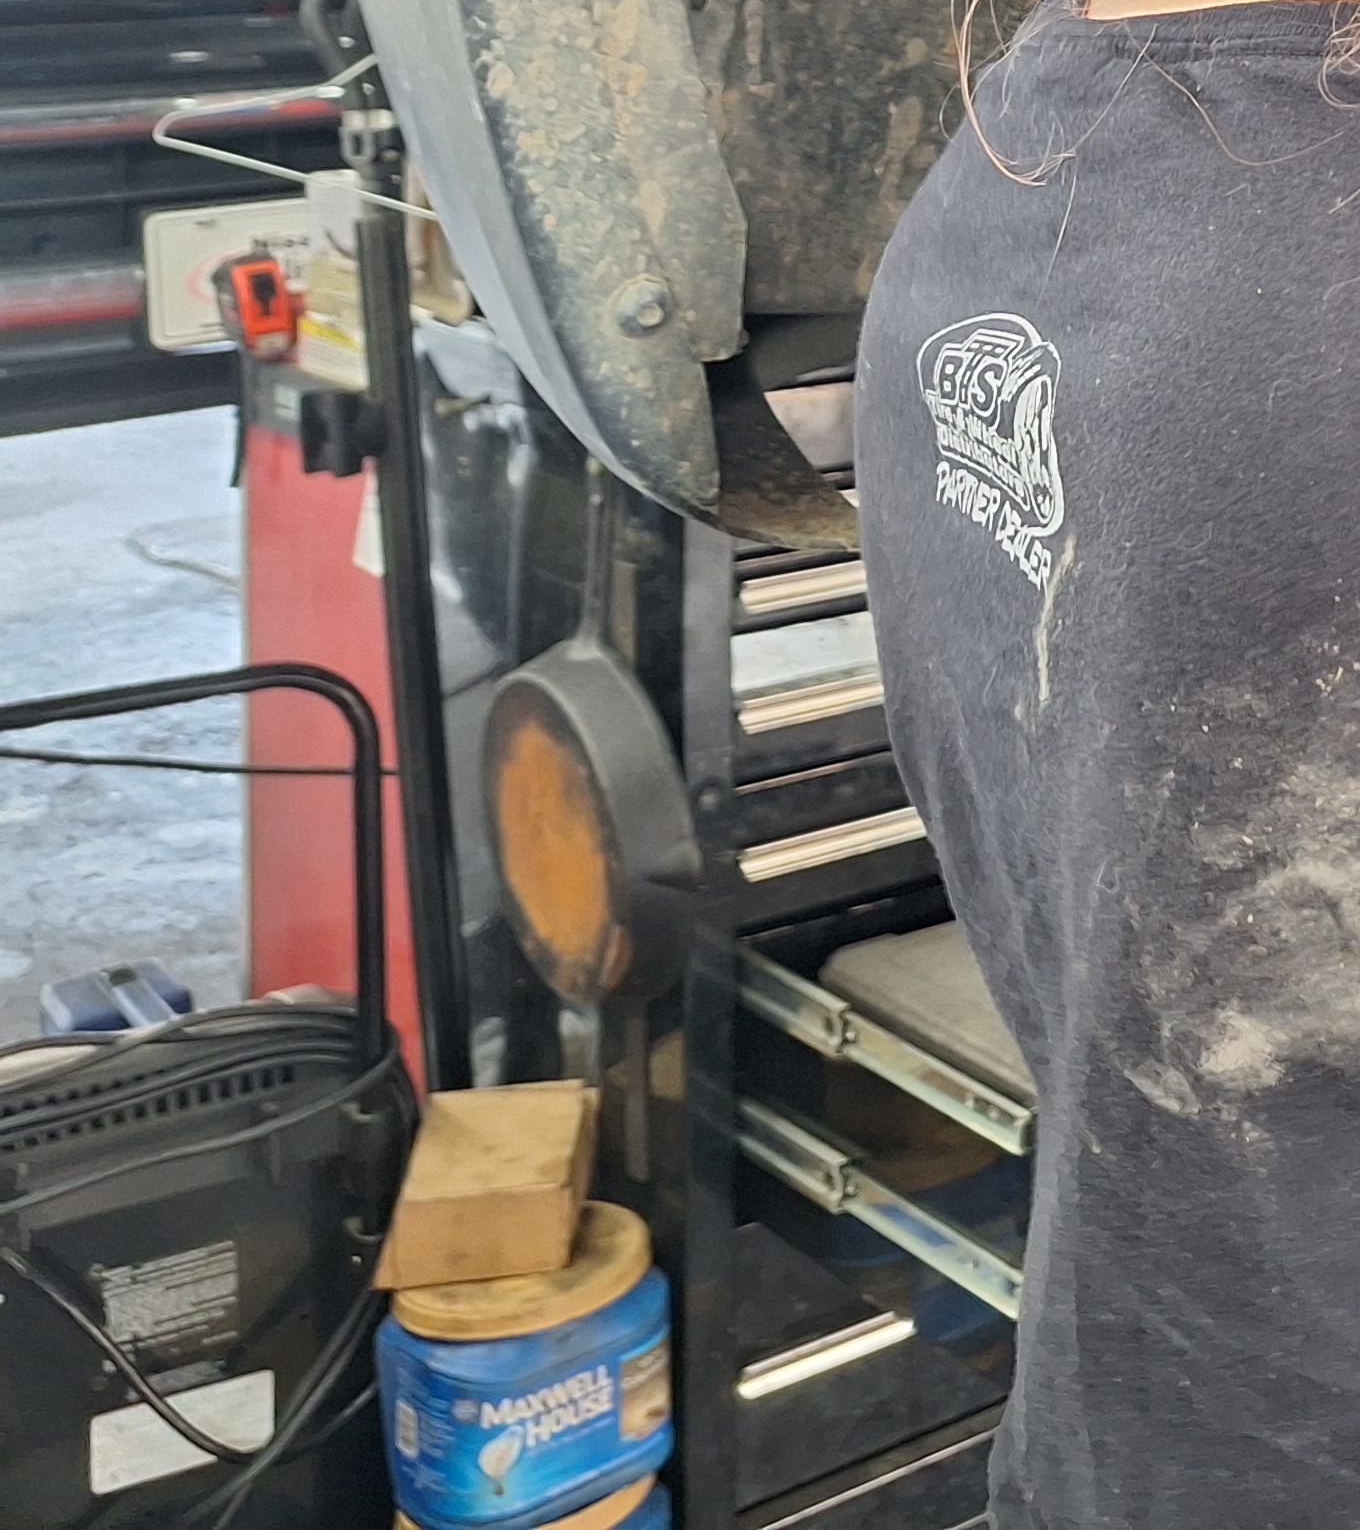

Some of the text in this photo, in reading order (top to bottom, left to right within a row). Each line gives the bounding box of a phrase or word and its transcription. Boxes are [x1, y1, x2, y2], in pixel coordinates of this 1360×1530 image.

[936, 461, 1052, 592] PARTNER DEALER
[480, 1364, 612, 1429] MAXWELL
[525, 1377, 613, 1447] HOUSE
